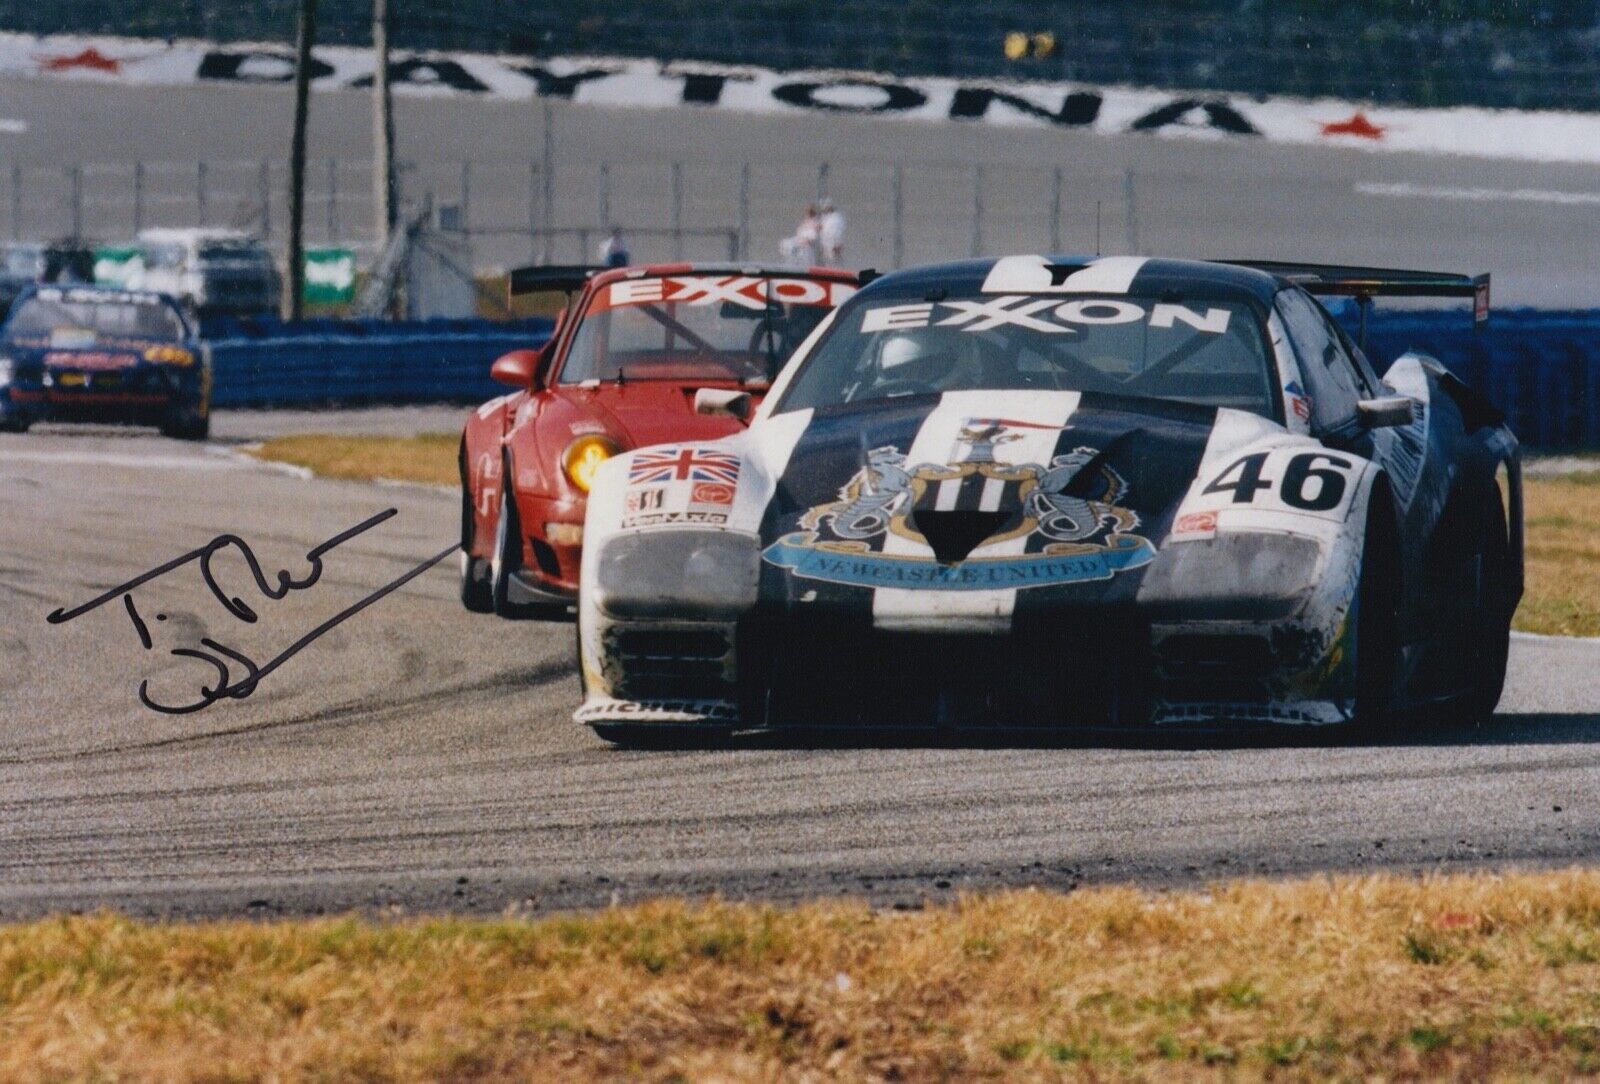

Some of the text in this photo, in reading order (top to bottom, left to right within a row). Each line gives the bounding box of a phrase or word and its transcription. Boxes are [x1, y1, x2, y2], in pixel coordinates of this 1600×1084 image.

[197, 52, 1264, 136] DAYTONA
[860, 296, 1231, 333] EXXON
[1202, 452, 1352, 511] 46
[986, 557, 1099, 583] UNITED
